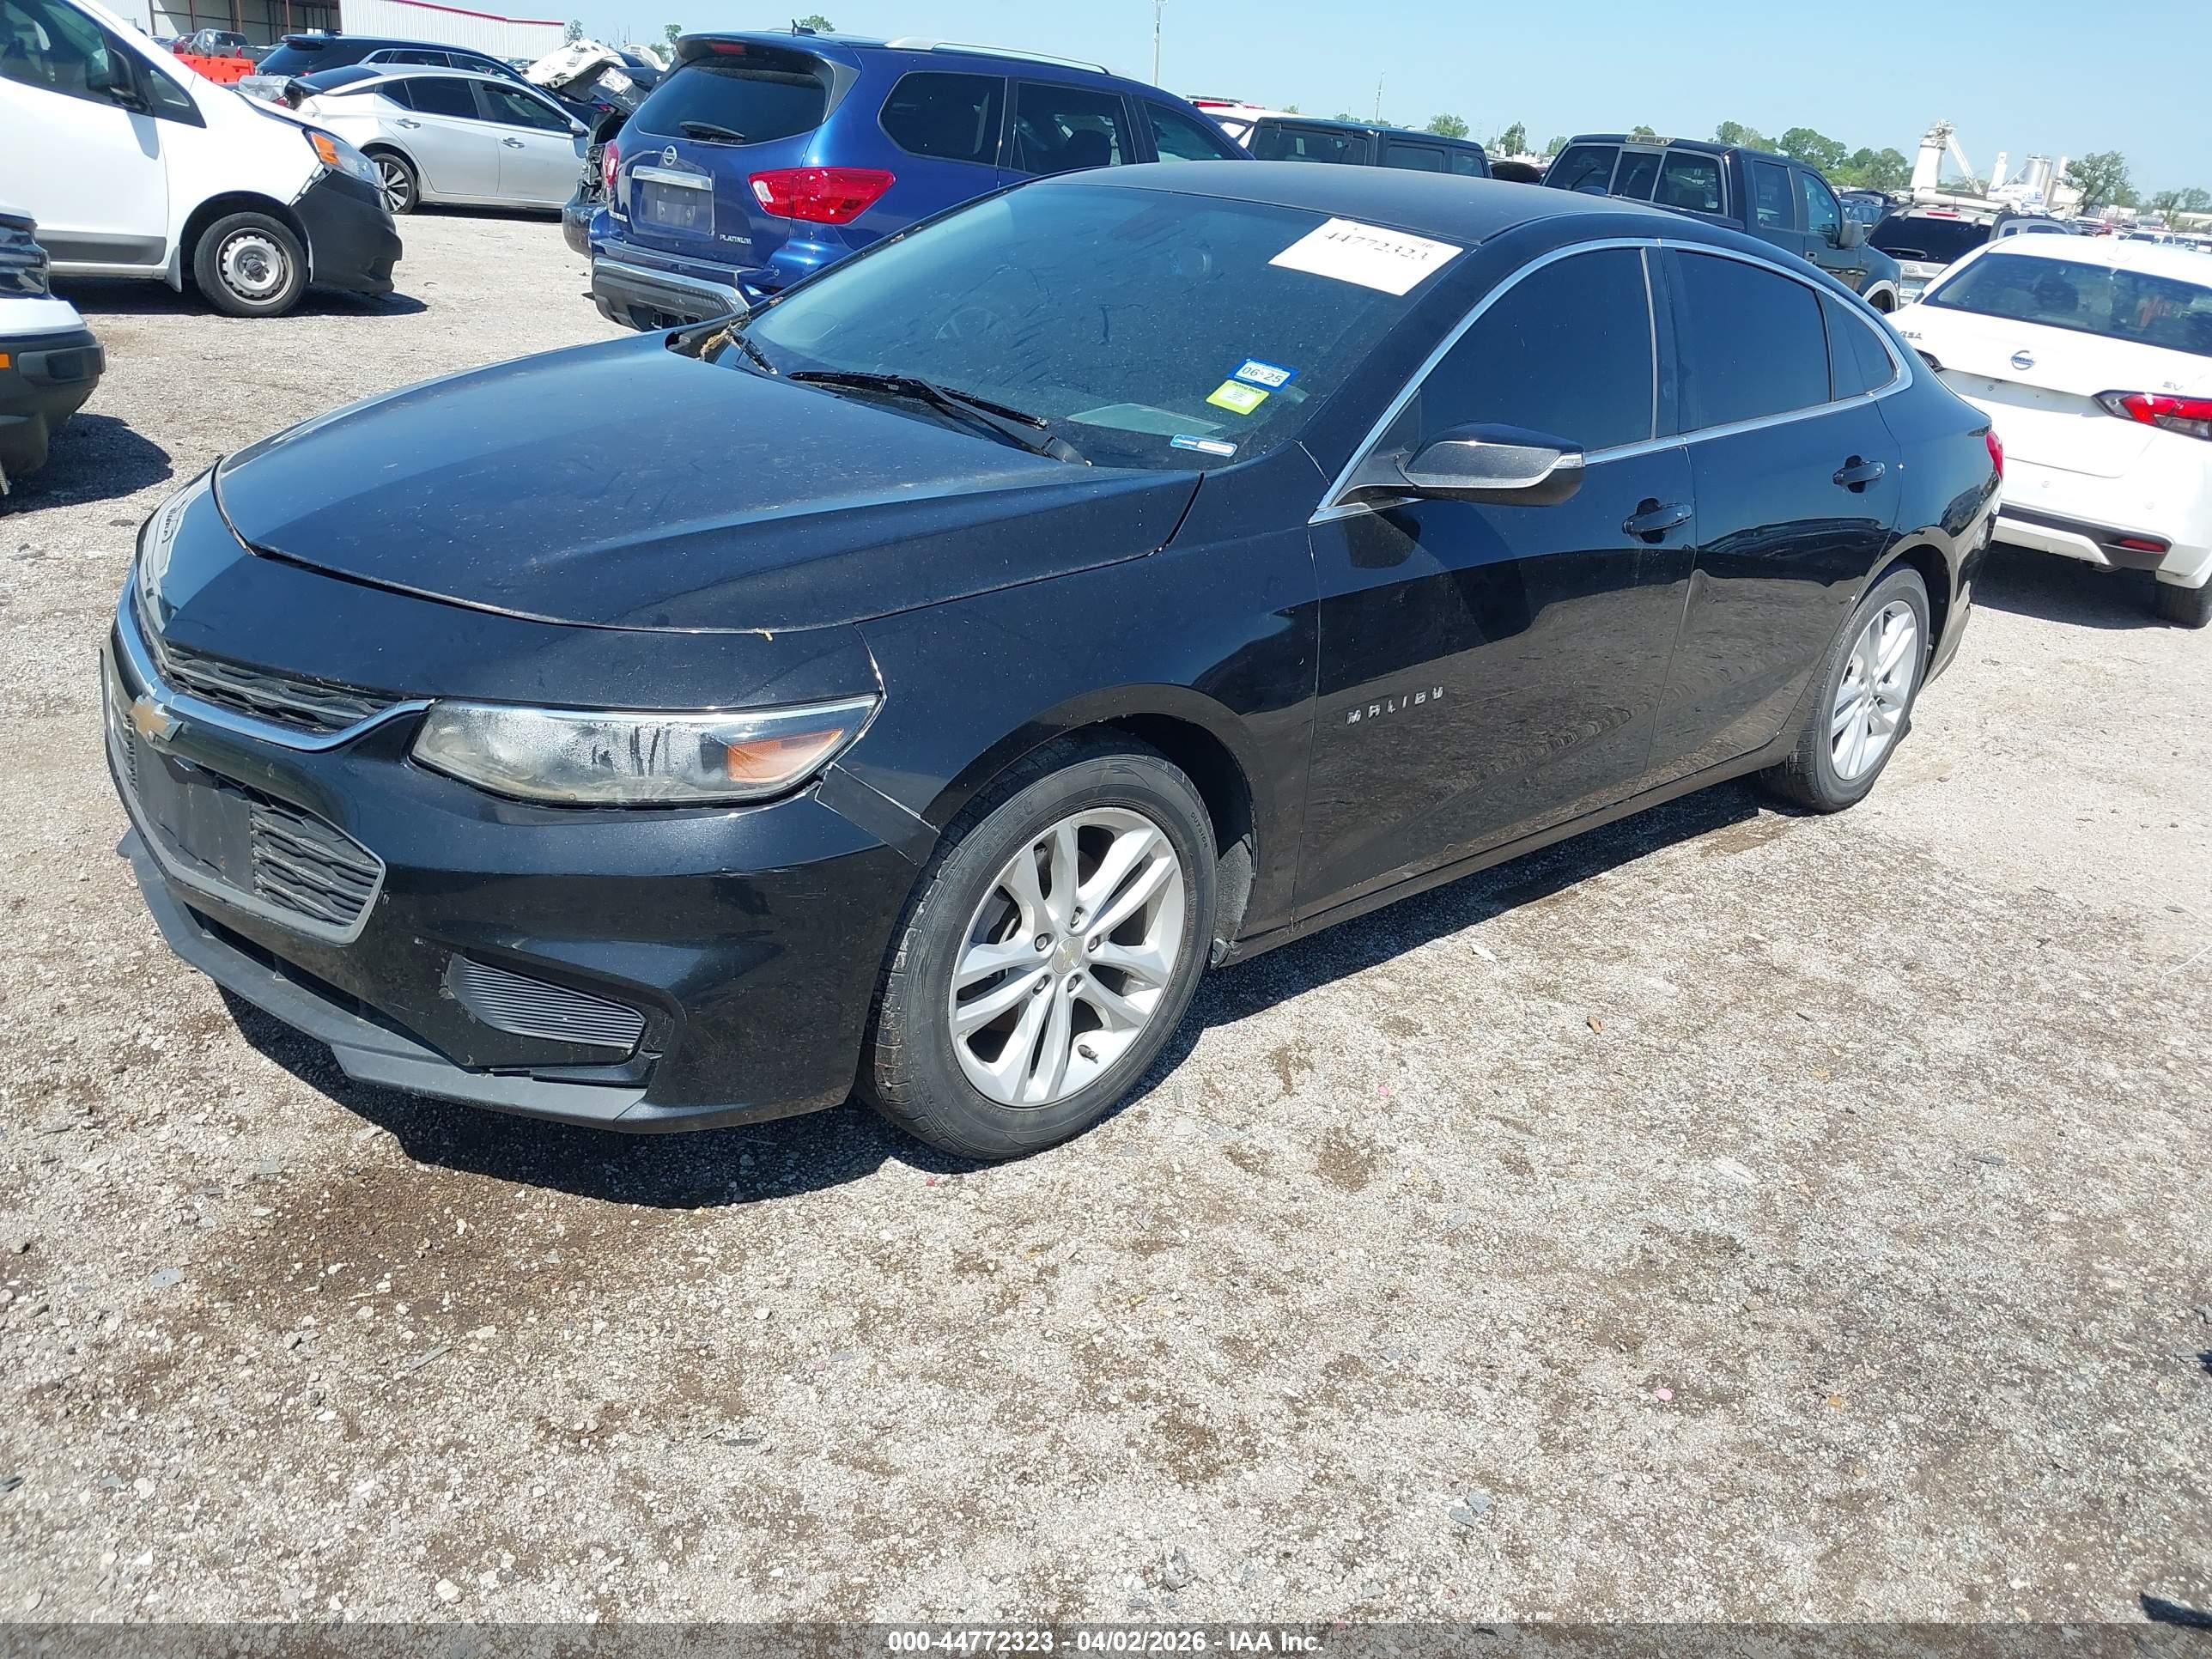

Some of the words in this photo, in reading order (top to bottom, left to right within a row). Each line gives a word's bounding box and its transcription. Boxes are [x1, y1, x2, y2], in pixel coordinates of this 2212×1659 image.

[1324, 230, 1429, 261] 44772323
[1899, 330, 1923, 340] RSA
[1346, 686, 1443, 726] MALIBU
